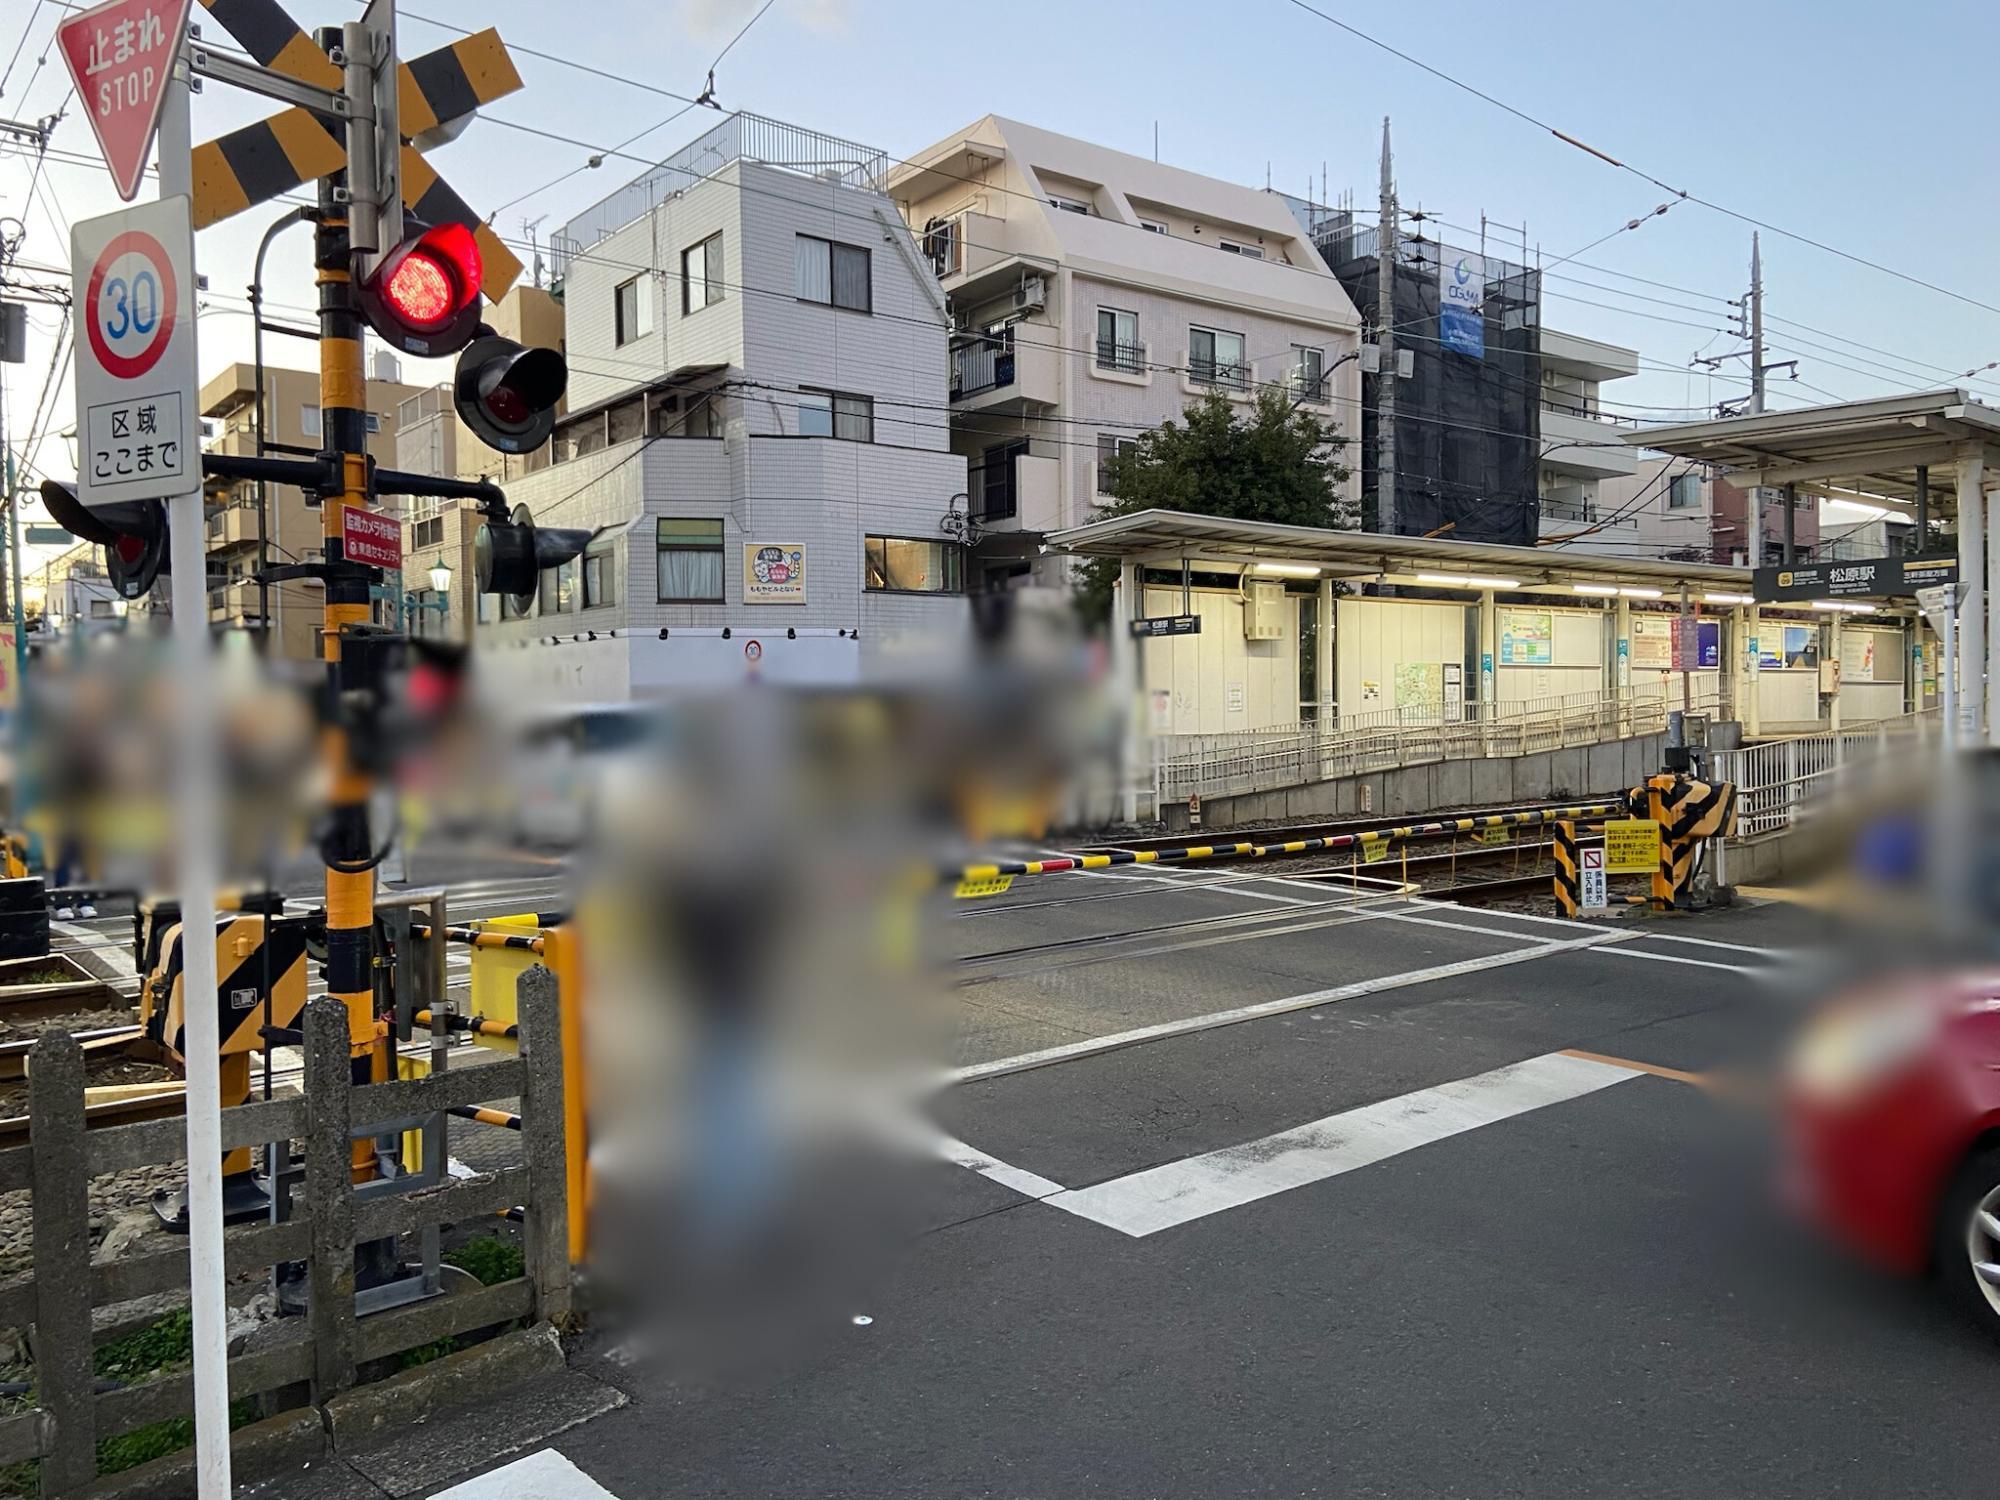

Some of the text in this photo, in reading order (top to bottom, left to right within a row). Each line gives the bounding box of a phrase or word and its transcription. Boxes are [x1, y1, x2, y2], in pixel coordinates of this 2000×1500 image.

[86, 8, 165, 76] 止まれ
[100, 66, 154, 116] STOP
[107, 271, 156, 339] 30
[111, 404, 157, 438] 区域
[95, 441, 178, 478] ここまで
[346, 512, 400, 542] 監視カメラ作動中
[1829, 565, 1875, 583] 松原駅
[1585, 872, 1593, 903] 立入禁止
